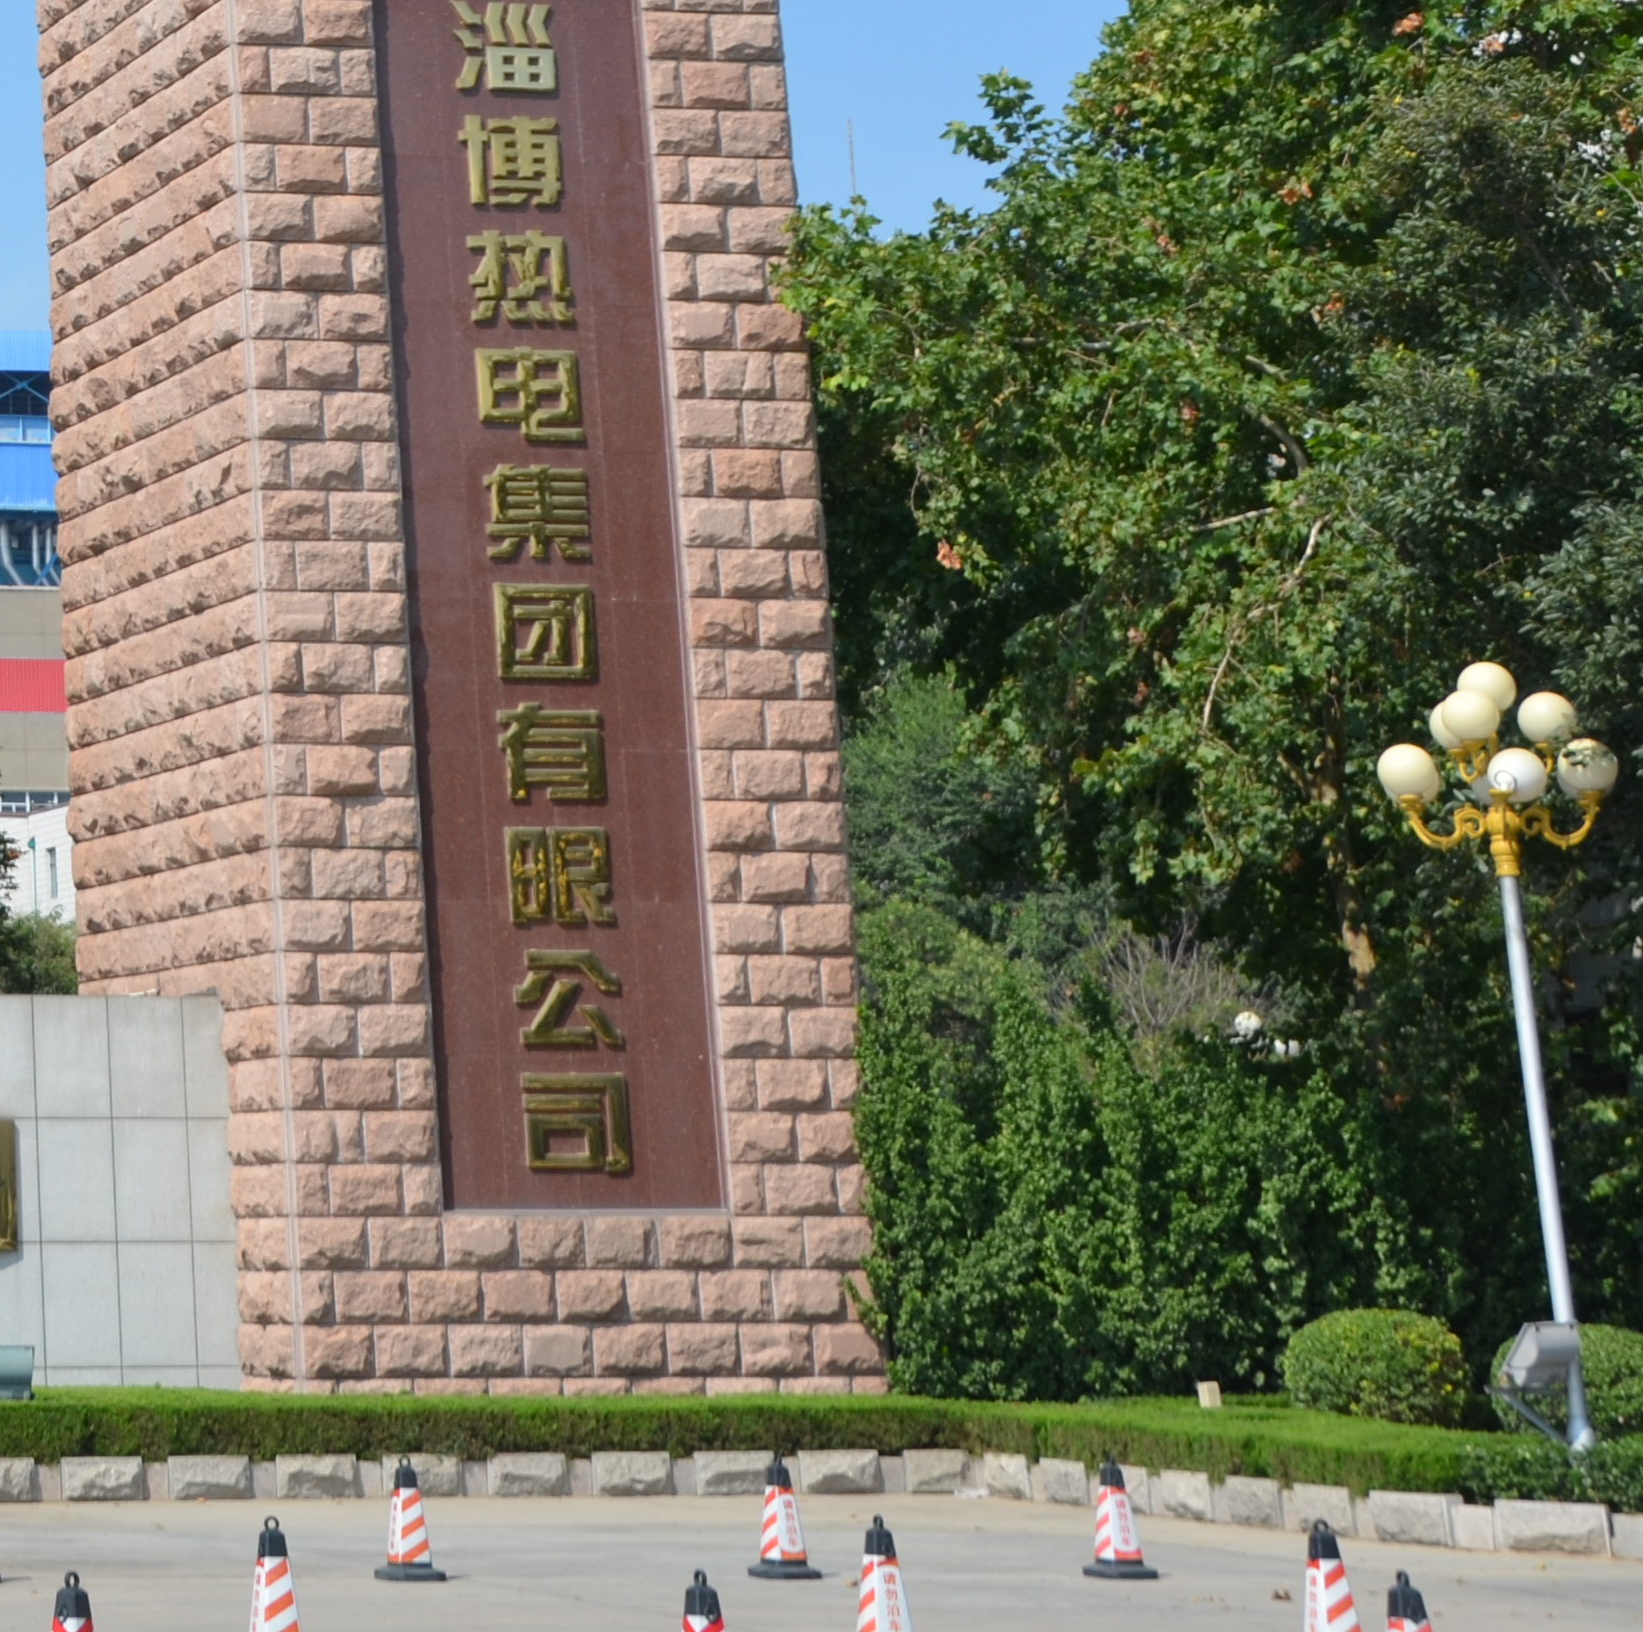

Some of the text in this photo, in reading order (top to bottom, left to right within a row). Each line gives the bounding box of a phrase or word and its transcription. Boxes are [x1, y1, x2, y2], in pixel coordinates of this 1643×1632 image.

[451, 0, 633, 1173] 淄博热电集团有限公司
